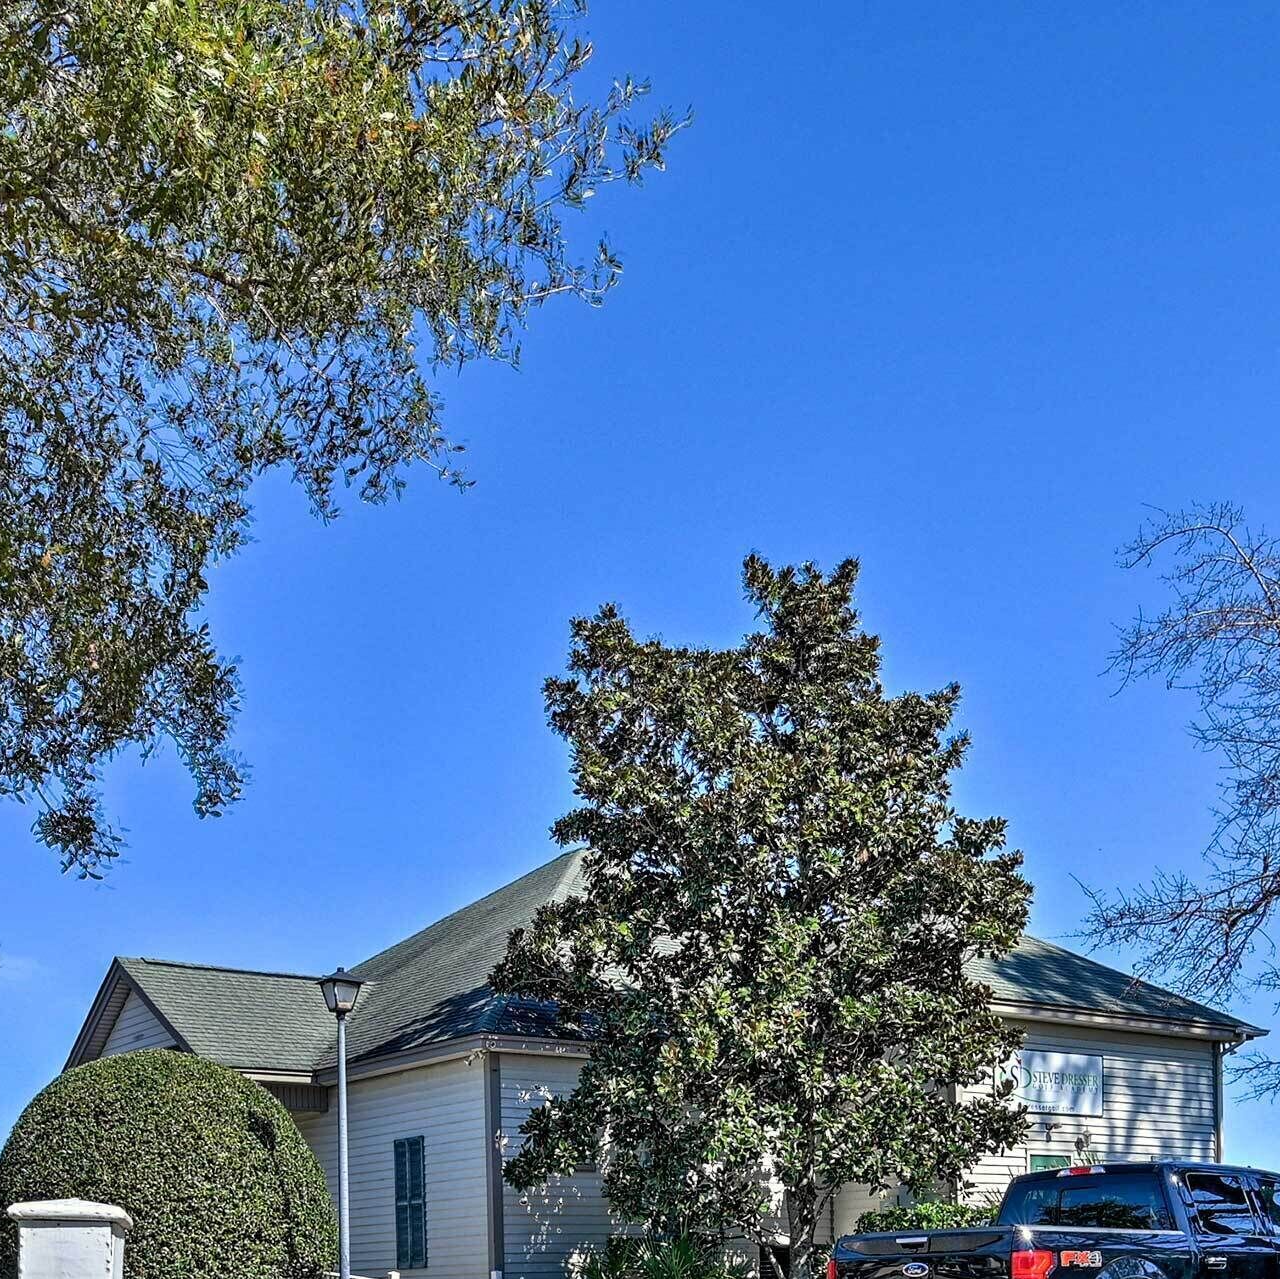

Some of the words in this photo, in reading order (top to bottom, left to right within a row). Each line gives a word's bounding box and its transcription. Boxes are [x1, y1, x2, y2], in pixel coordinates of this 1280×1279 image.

[1032, 1071, 1060, 1085] STEVE
[1061, 1072, 1099, 1087] DRESSER
[1060, 1250, 1102, 1268] FX4
